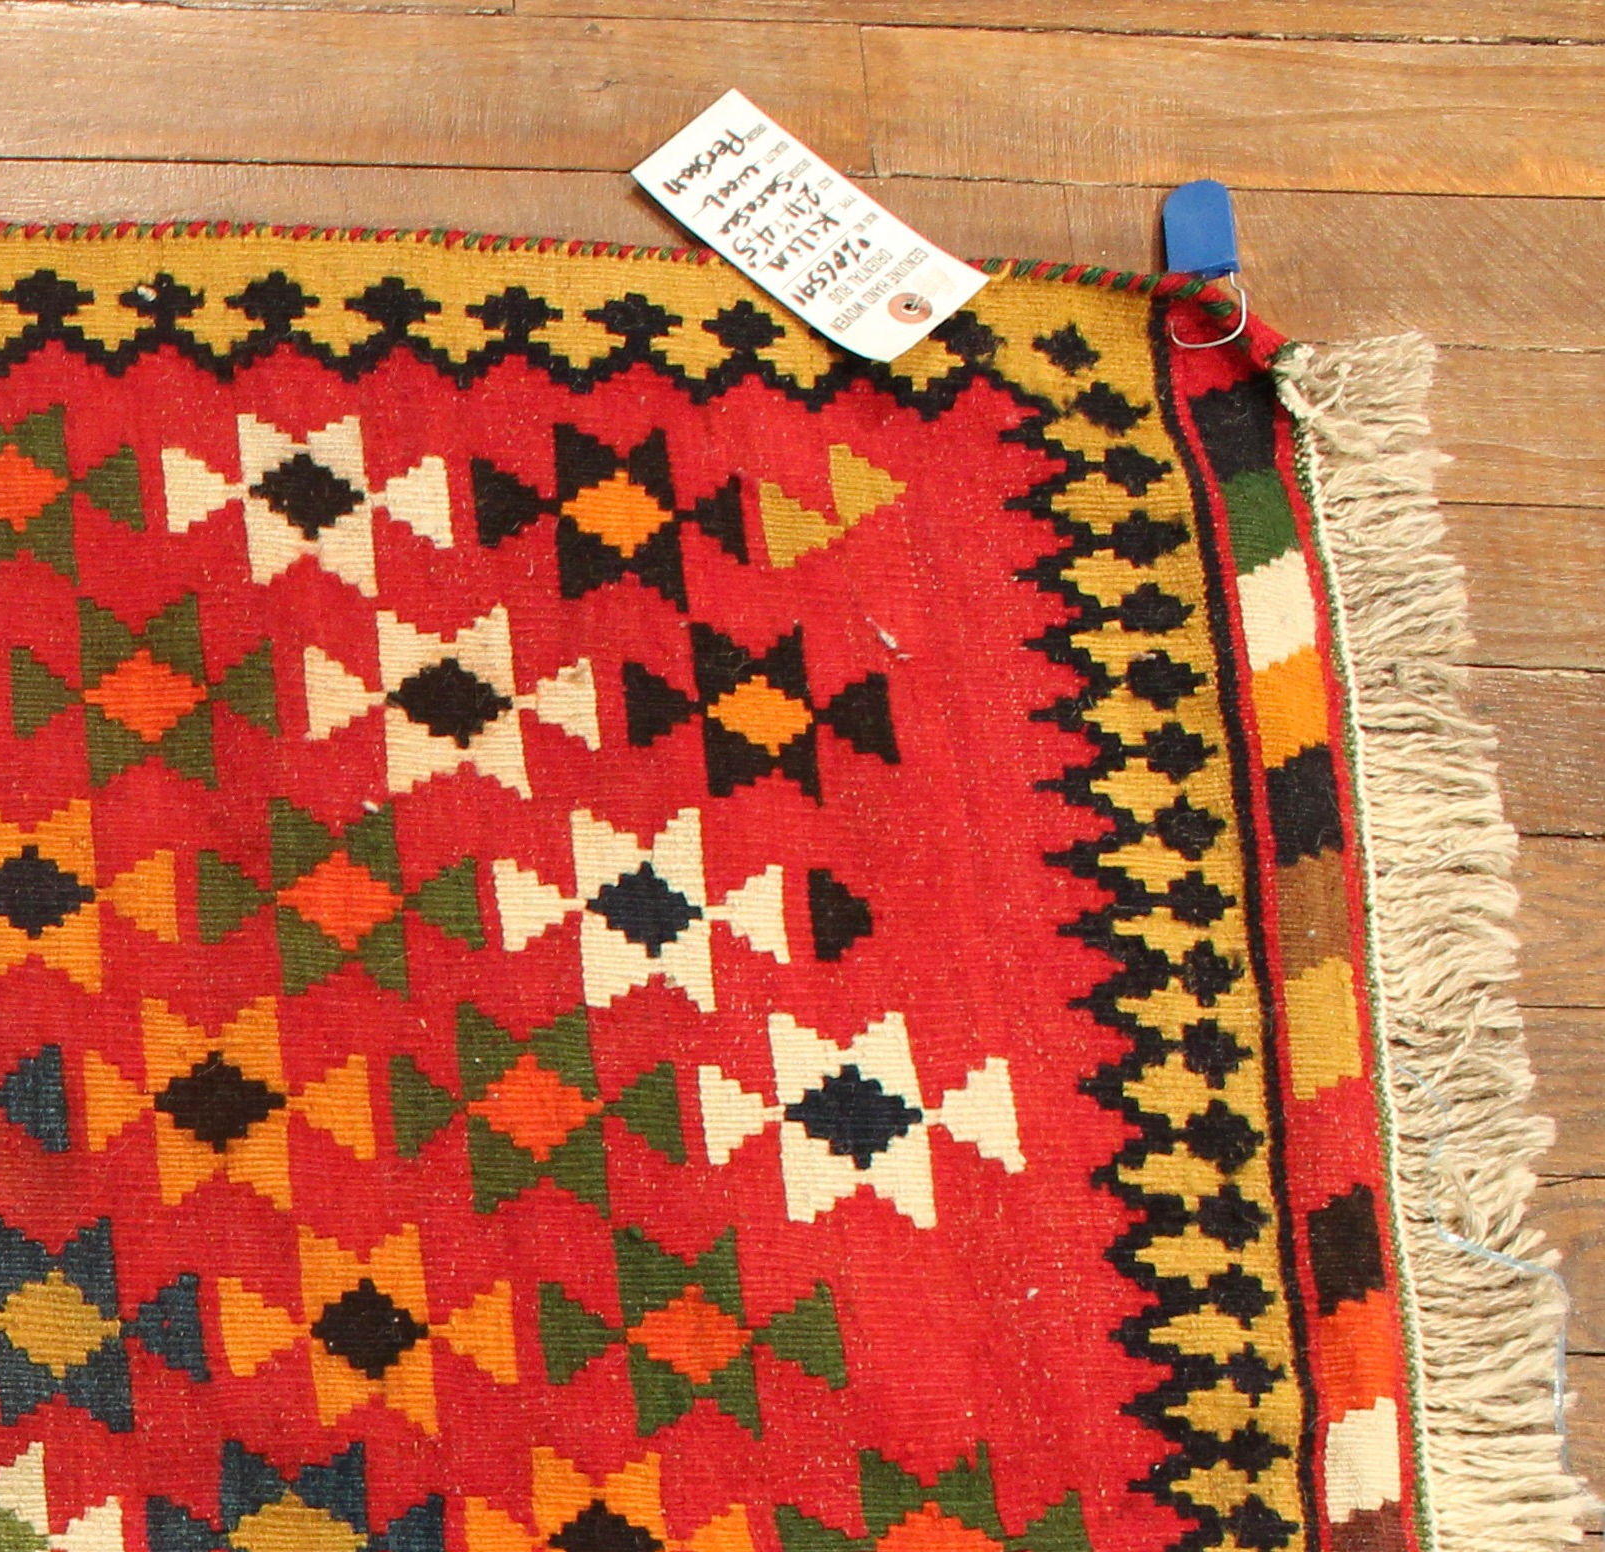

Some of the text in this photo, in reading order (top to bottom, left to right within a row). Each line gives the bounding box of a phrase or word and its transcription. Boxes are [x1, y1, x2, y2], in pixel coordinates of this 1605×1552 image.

[828, 248, 892, 304] ORIENTAL RUG
[830, 247, 928, 331] GENUINE HAND WOVEN
